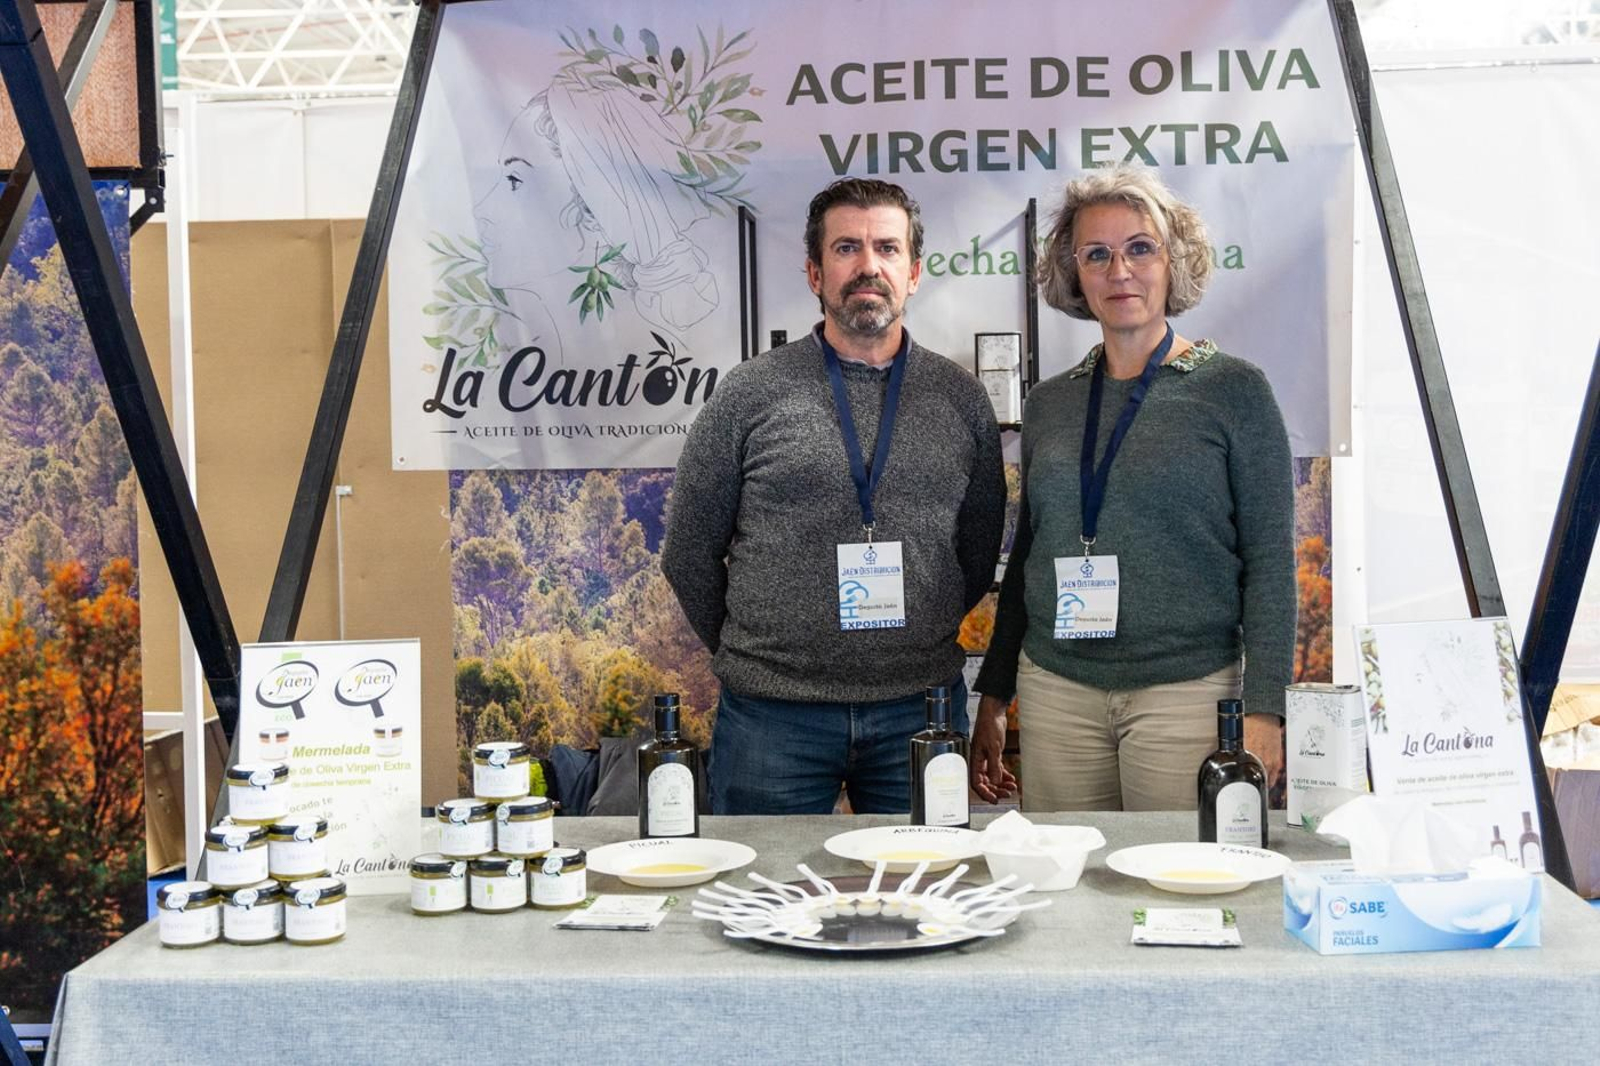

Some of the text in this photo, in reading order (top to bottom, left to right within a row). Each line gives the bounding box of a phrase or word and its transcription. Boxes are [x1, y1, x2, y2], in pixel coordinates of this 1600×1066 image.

[786, 47, 1321, 106] ACEITE DE OLIVA
[818, 119, 1291, 176] VIRGEN EXTRA
[926, 234, 1022, 277] echa
[422, 340, 719, 419] La Canton
[464, 422, 690, 440] ACEITE DE OLIVA TRADICION
[840, 618, 907, 630] EXPOSITOR
[292, 743, 371, 759] Mermelada
[1401, 730, 1494, 757] La Cantona
[316, 764, 344, 774] Oliva
[345, 762, 381, 774] Virgen
[383, 760, 411, 771] Extra
[335, 858, 351, 876] La
[1348, 900, 1386, 914] SABE
[1332, 936, 1380, 947] FACIALES
